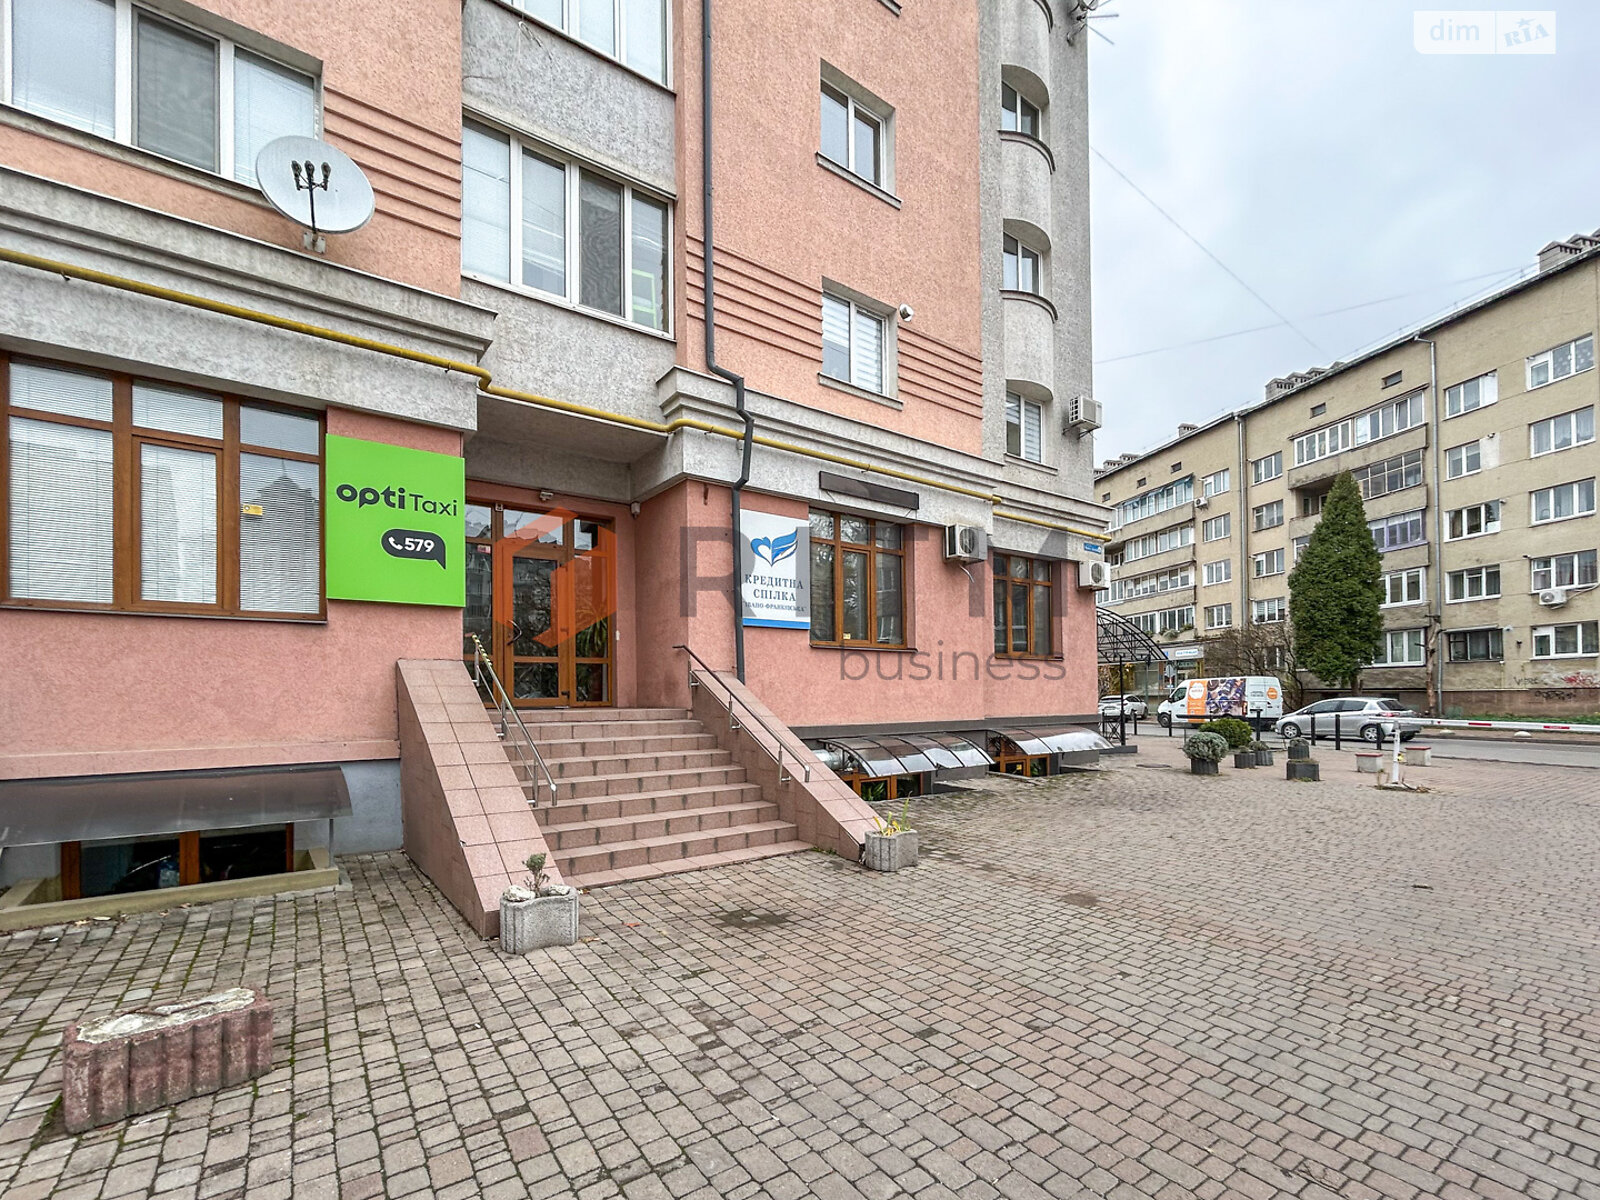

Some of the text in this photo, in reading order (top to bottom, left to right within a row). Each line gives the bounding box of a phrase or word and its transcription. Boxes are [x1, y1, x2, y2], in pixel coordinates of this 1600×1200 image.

[404, 537, 435, 553] 579
[745, 574, 804, 589] КРЕДИТНА
[753, 589, 796, 602] СПІЛКА
